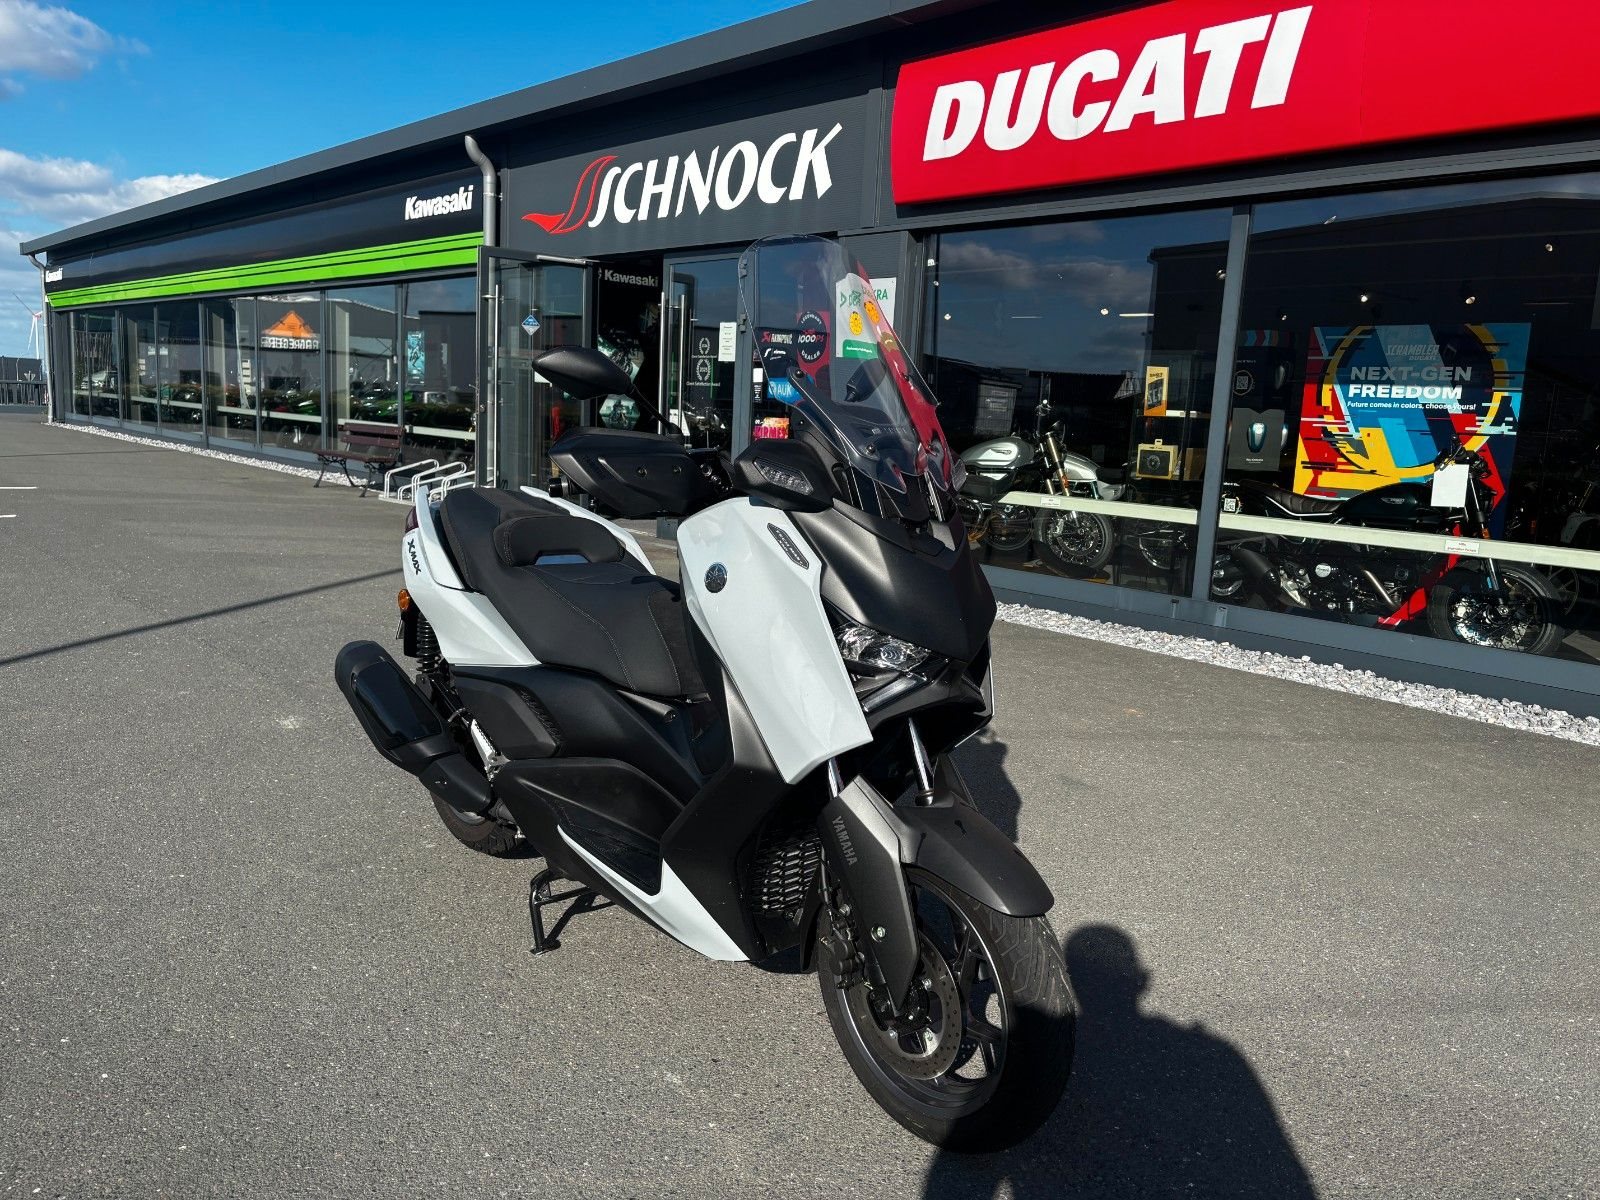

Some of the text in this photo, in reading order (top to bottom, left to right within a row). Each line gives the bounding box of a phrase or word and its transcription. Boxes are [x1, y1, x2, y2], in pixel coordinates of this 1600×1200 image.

[922, 5, 1313, 161] DUCATI
[588, 122, 843, 228] SCHNOCK
[404, 184, 474, 221] Kawasaki
[604, 269, 659, 287] Kawasaki
[801, 349, 821, 361] DEALER
[1386, 344, 1440, 356] SCRAMBLER
[1350, 366, 1472, 381] NEXT-GEN
[1348, 384, 1463, 399] FREEDOM
[1452, 403, 1477, 411] yours!
[832, 815, 858, 866] YAMAHA
